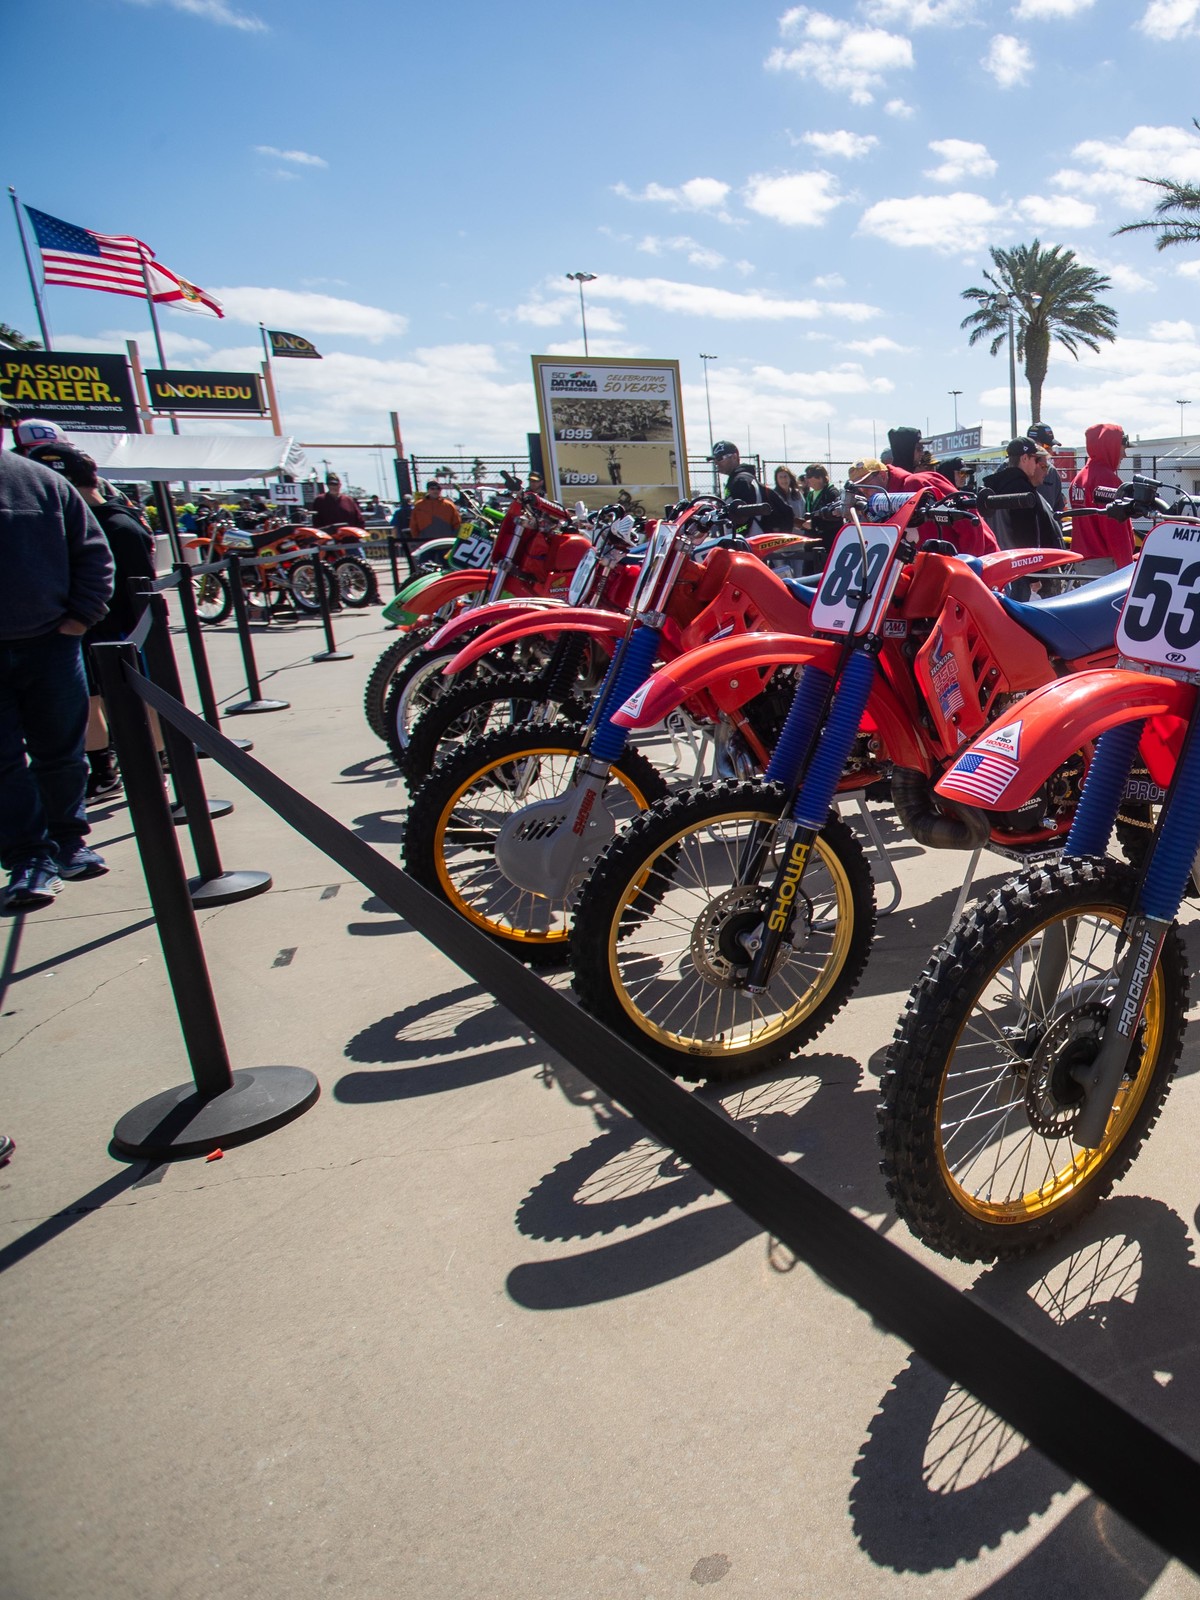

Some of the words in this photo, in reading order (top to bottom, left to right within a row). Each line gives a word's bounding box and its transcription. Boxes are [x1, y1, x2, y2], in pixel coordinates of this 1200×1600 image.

[6, 362, 101, 381] PASSION
[607, 374, 665, 383] CELEBRATING
[0, 378, 122, 403] CAREER.
[156, 382, 252, 400] UNOH.EDU
[552, 380, 597, 388] DAYTONA
[603, 382, 621, 393] 50
[624, 383, 667, 393] YEARS
[559, 428, 593, 440] 1995
[946, 431, 980, 450] TICKETS
[564, 473, 598, 485] 1999
[275, 485, 296, 495] EXIT
[760, 537, 799, 549] DUNLOP
[453, 537, 491, 567] 29
[1011, 555, 1044, 568] DUNLOP
[930, 651, 954, 677] HONDA
[932, 658, 959, 693] 250
[985, 739, 1014, 752] HONDA
[995, 736, 1012, 744] PRO
[572, 788, 597, 837] SHOWA
[768, 842, 810, 932] SHOWA
[1117, 1001, 1137, 1038] PRO
[1128, 932, 1157, 1000] CIRCUIT
